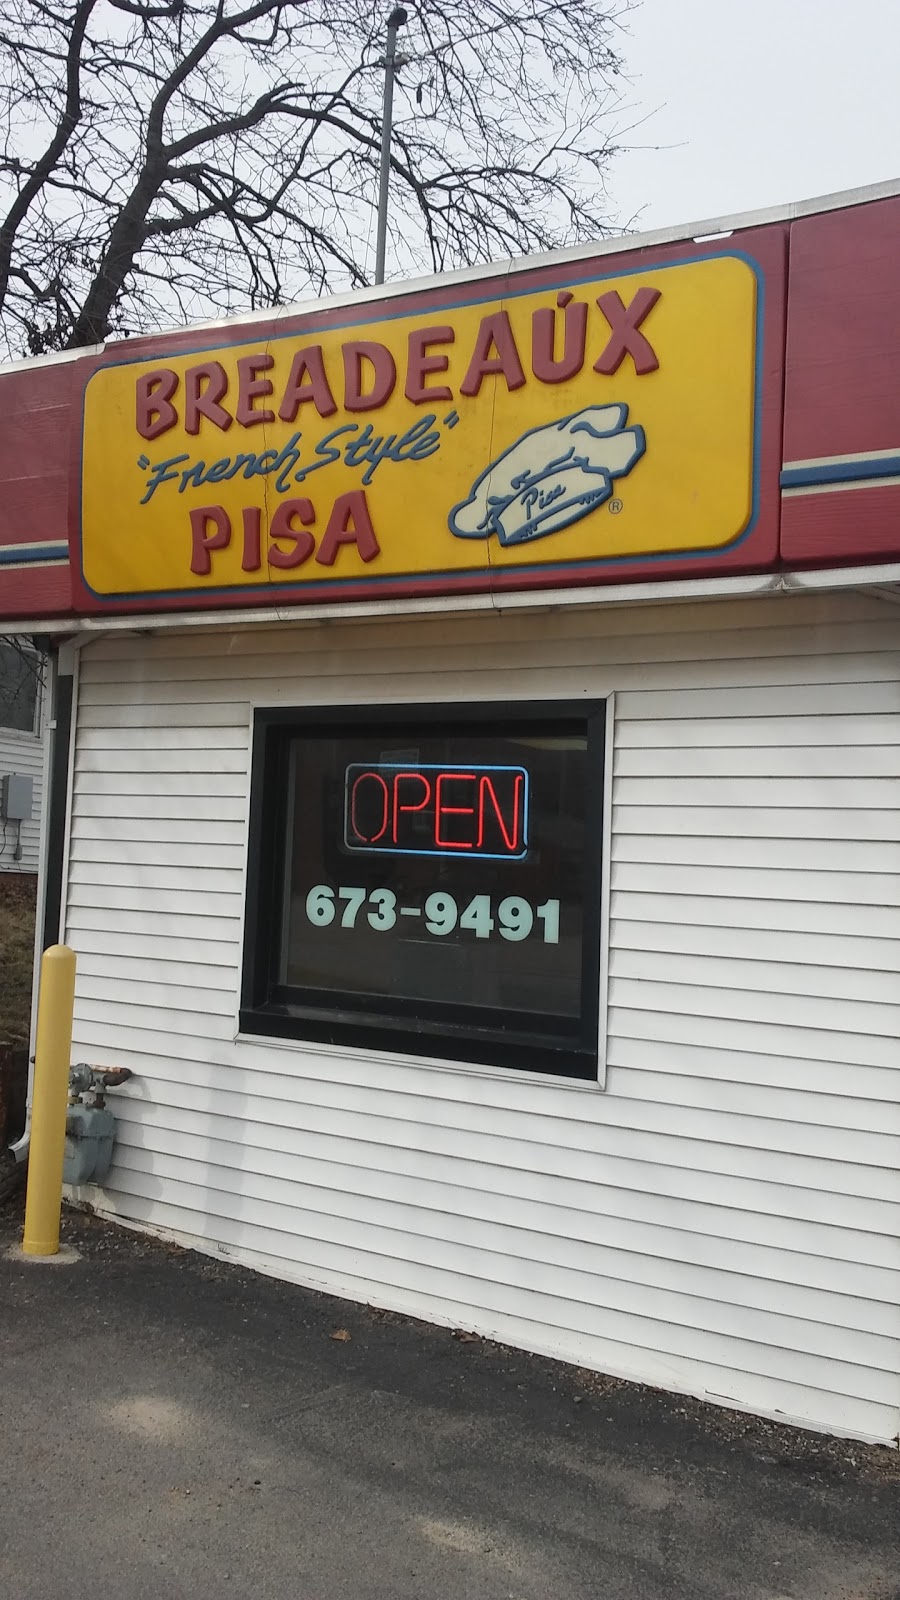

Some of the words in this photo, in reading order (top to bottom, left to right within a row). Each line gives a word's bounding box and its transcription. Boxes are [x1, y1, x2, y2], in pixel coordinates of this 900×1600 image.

[189, 489, 381, 576] PISA
[351, 772, 523, 850] OPEN
[305, 884, 561, 944] 673-9491
